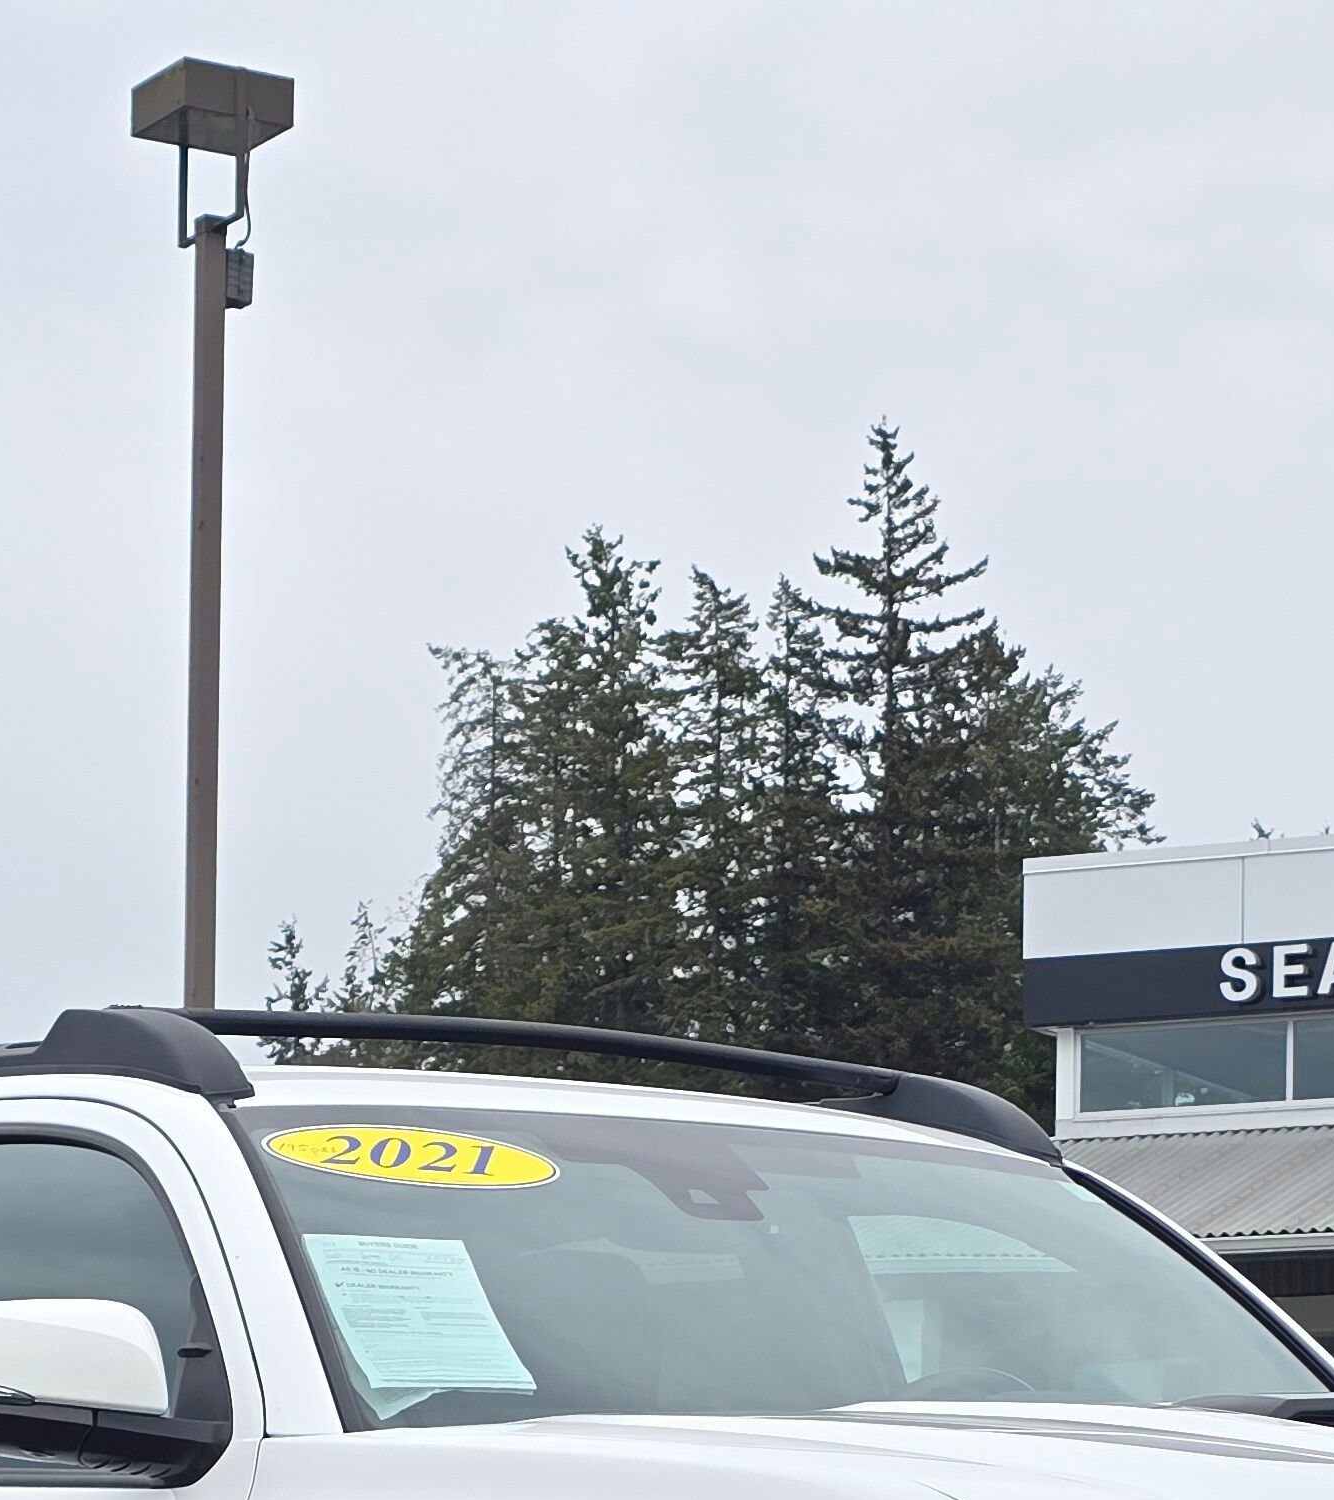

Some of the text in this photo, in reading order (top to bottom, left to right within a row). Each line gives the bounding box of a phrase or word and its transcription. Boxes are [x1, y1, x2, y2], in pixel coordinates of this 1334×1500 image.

[320, 1135, 496, 1177] 2021
[377, 1268, 409, 1276] DEALER
[410, 1269, 454, 1278] WARRANTY
[346, 1282, 377, 1290] DEALER
